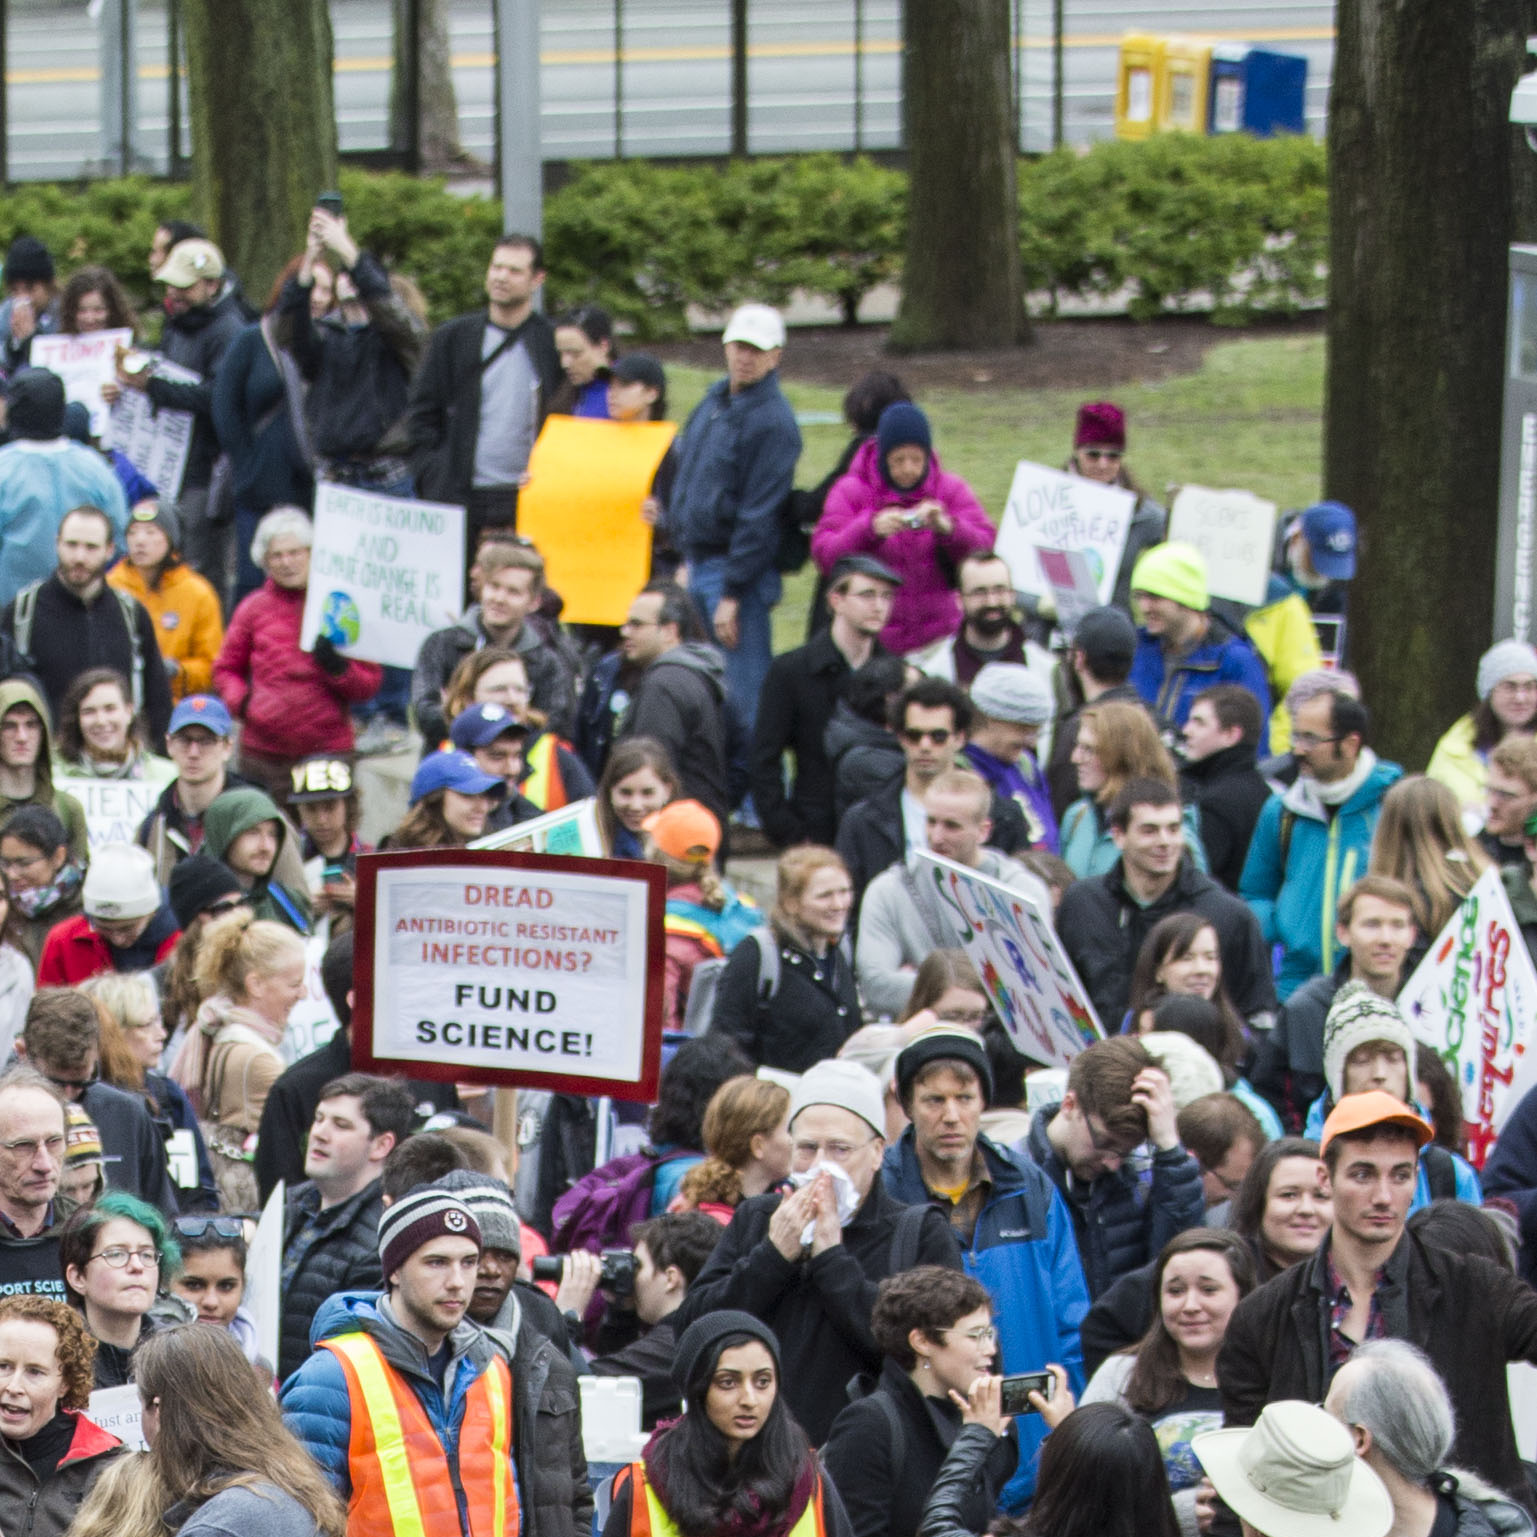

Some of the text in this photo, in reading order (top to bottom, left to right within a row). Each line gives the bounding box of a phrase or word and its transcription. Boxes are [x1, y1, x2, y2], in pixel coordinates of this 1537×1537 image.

[384, 503, 445, 535] ROUND
[1012, 482, 1075, 529] LOVE
[353, 532, 398, 563] AND
[359, 560, 421, 595] CHANGE
[425, 570, 442, 600] IS
[381, 593, 436, 629] REAL
[290, 758, 352, 794] YES
[464, 884, 554, 910] DREAD
[394, 917, 620, 946] ANTIBIOTIC RESISTANT
[421, 942, 593, 973] INFECTIONS?
[453, 983, 558, 1014] FUND
[415, 1019, 593, 1058] SCIENCE!
